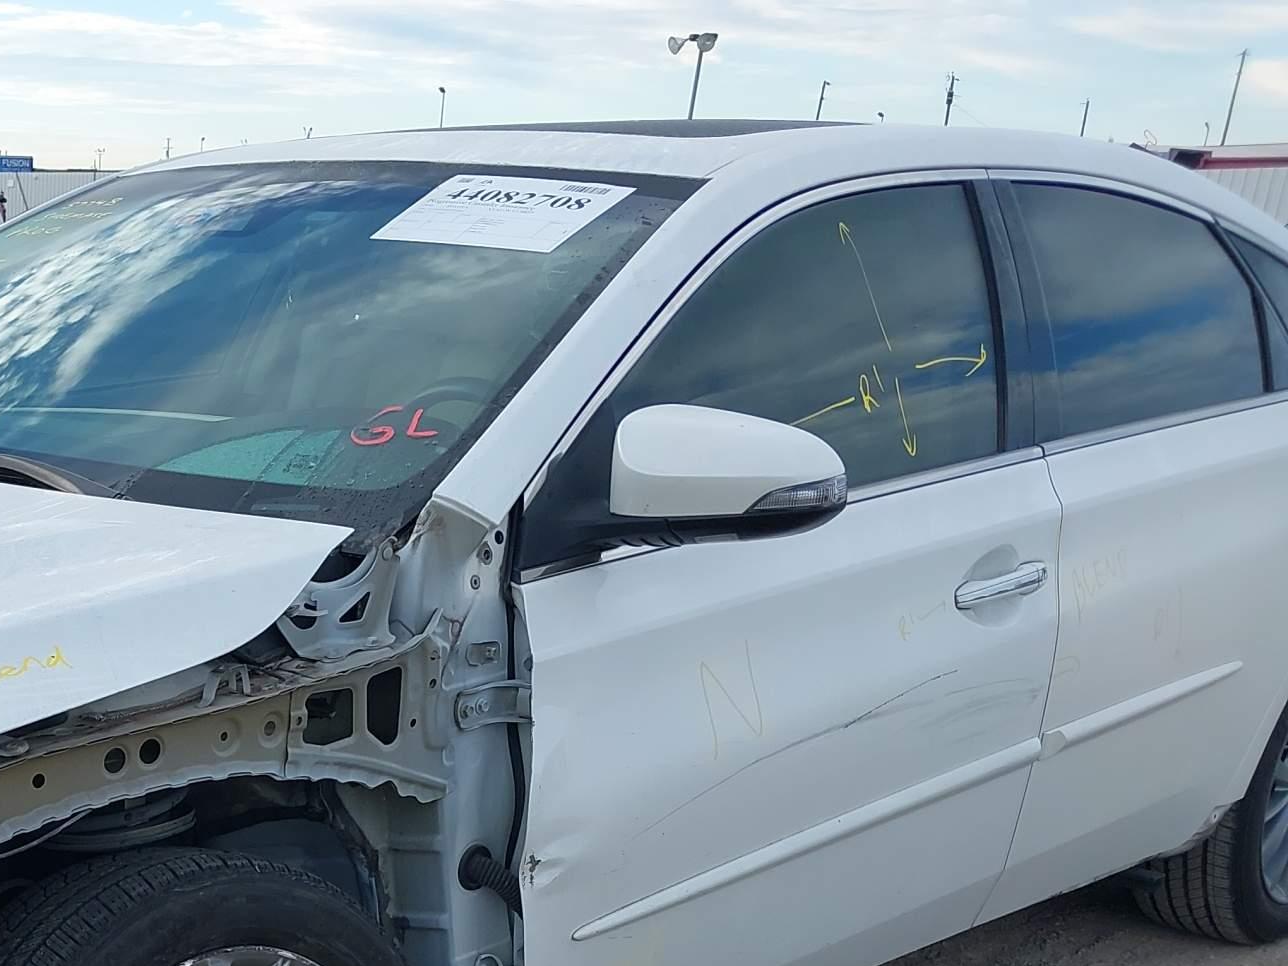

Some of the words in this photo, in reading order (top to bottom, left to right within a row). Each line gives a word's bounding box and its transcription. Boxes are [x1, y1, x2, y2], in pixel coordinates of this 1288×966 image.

[2, 159, 30, 168] FUSION
[446, 187, 592, 211] 44082708
[350, 405, 440, 446] GL
